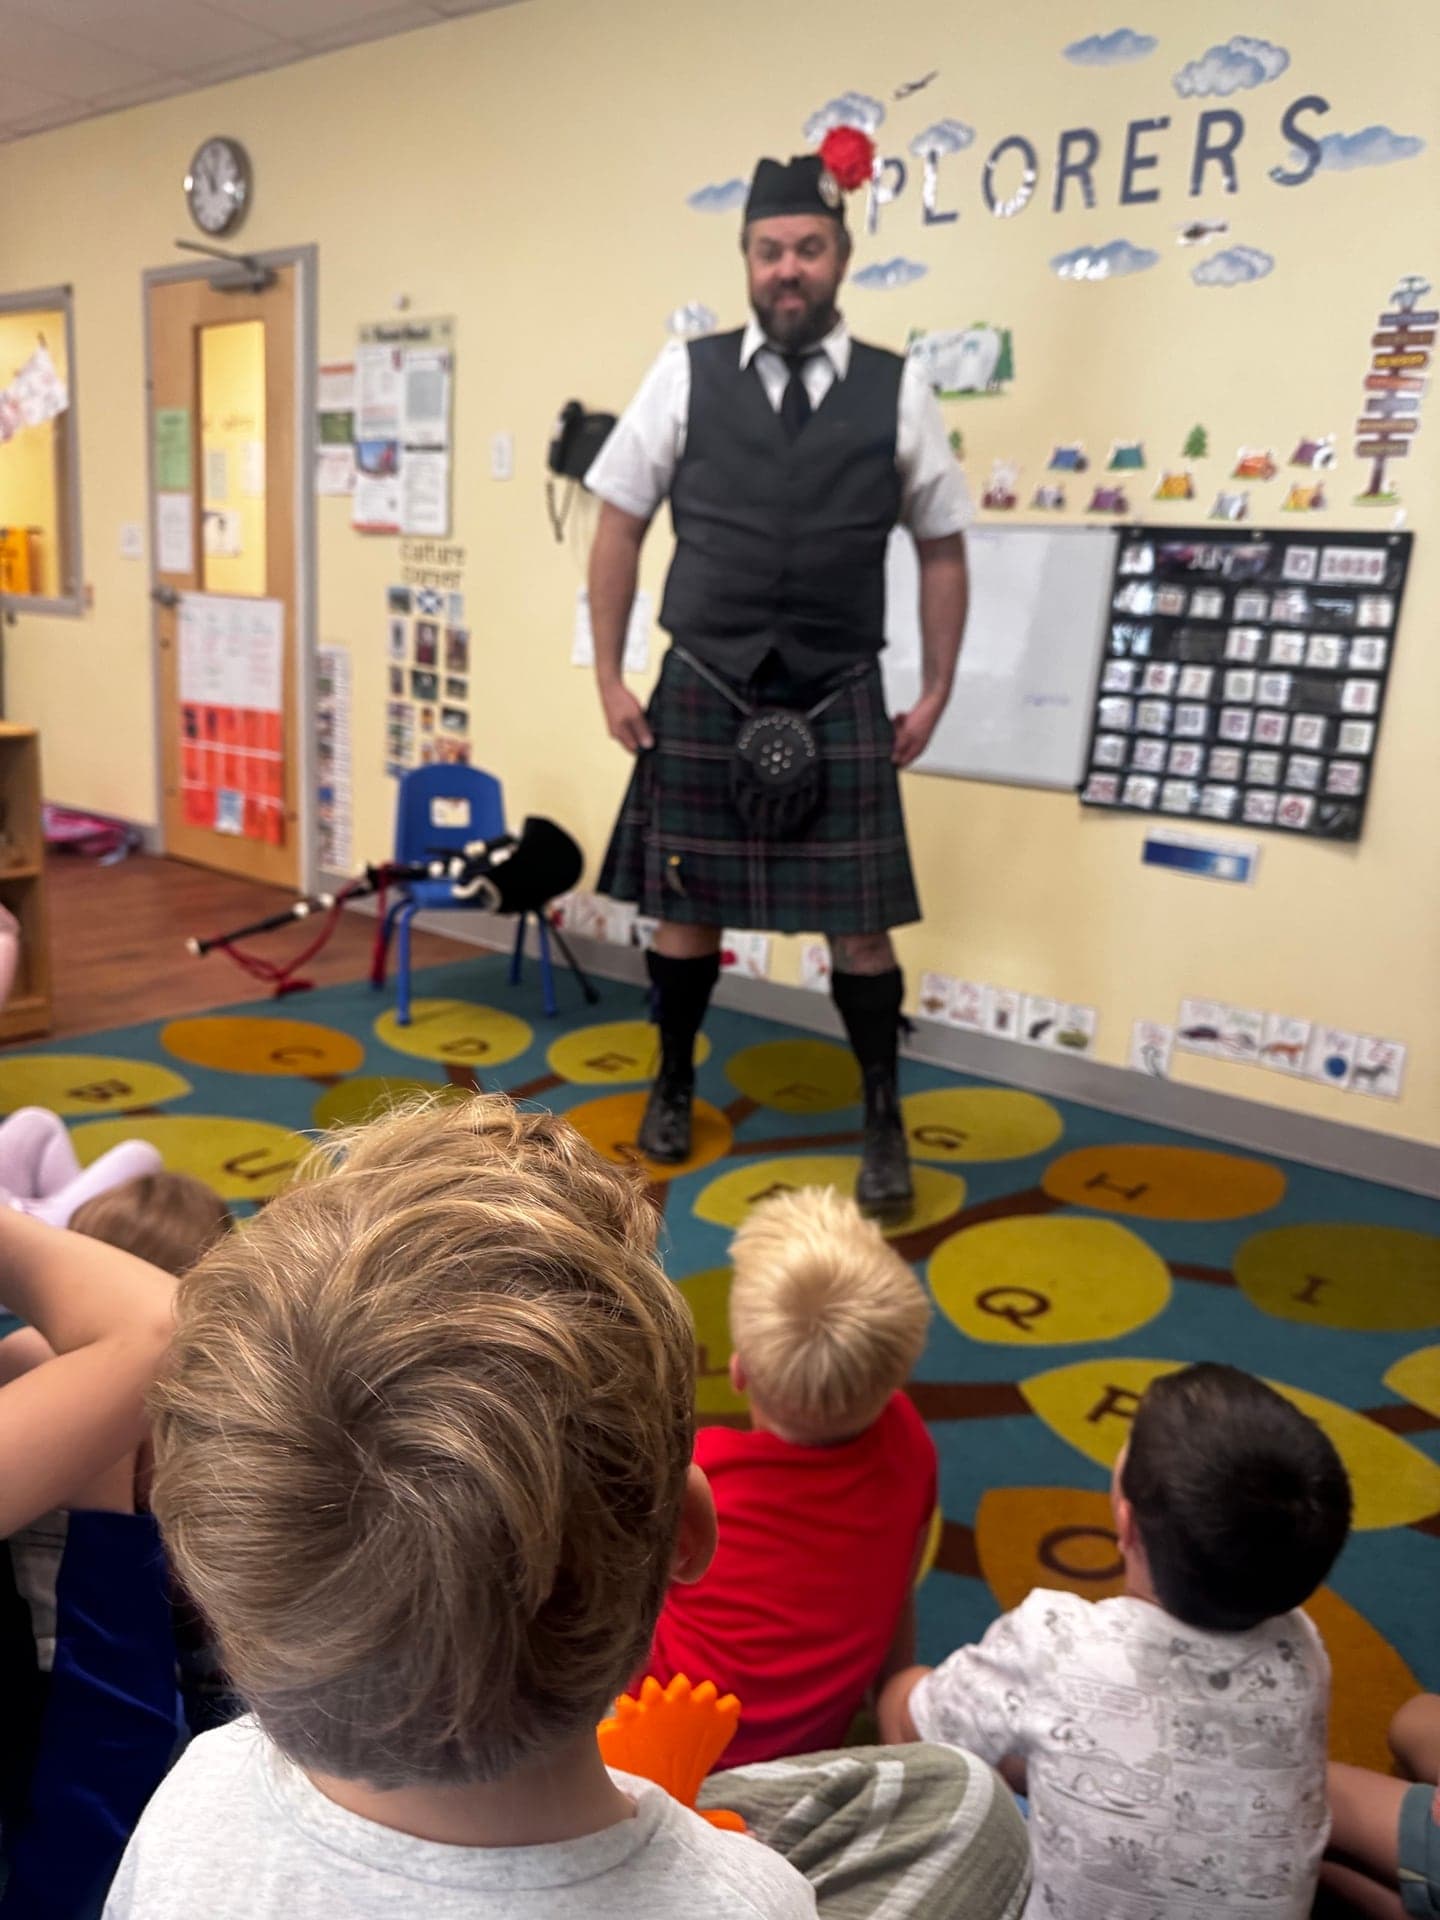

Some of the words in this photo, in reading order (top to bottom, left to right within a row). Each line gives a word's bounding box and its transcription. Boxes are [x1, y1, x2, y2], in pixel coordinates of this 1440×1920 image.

[866, 95, 1330, 233] PLORERS
[269, 1045, 326, 1065] C
[439, 1037, 490, 1057] D
[584, 1052, 639, 1073] E
[911, 1124, 968, 1150] G
[1290, 1273, 1331, 1306] I
[975, 1285, 1051, 1332] Q
[1036, 1524, 1127, 1582] O
